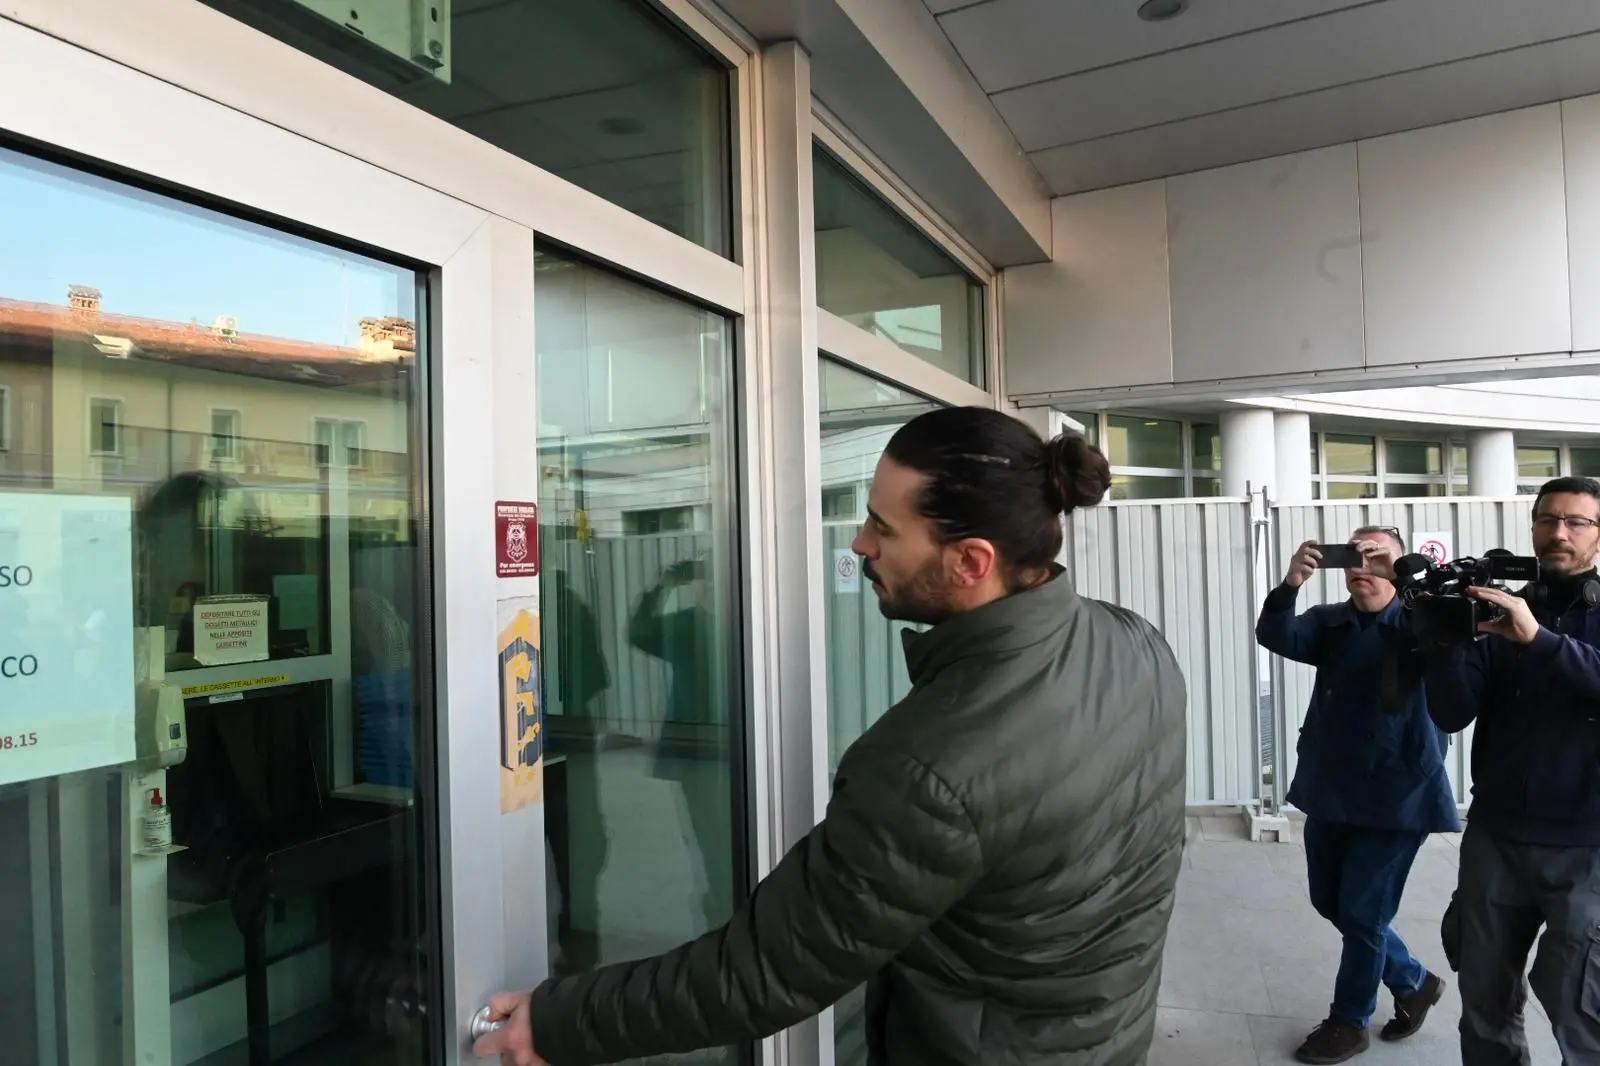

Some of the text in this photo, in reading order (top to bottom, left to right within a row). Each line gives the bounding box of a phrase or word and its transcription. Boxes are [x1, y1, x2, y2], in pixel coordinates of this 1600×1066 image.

[0, 565, 33, 587] SO
[230, 620, 257, 628] METALLICI
[1, 654, 38, 678] CO
[209, 680, 243, 691] CASSETTE
